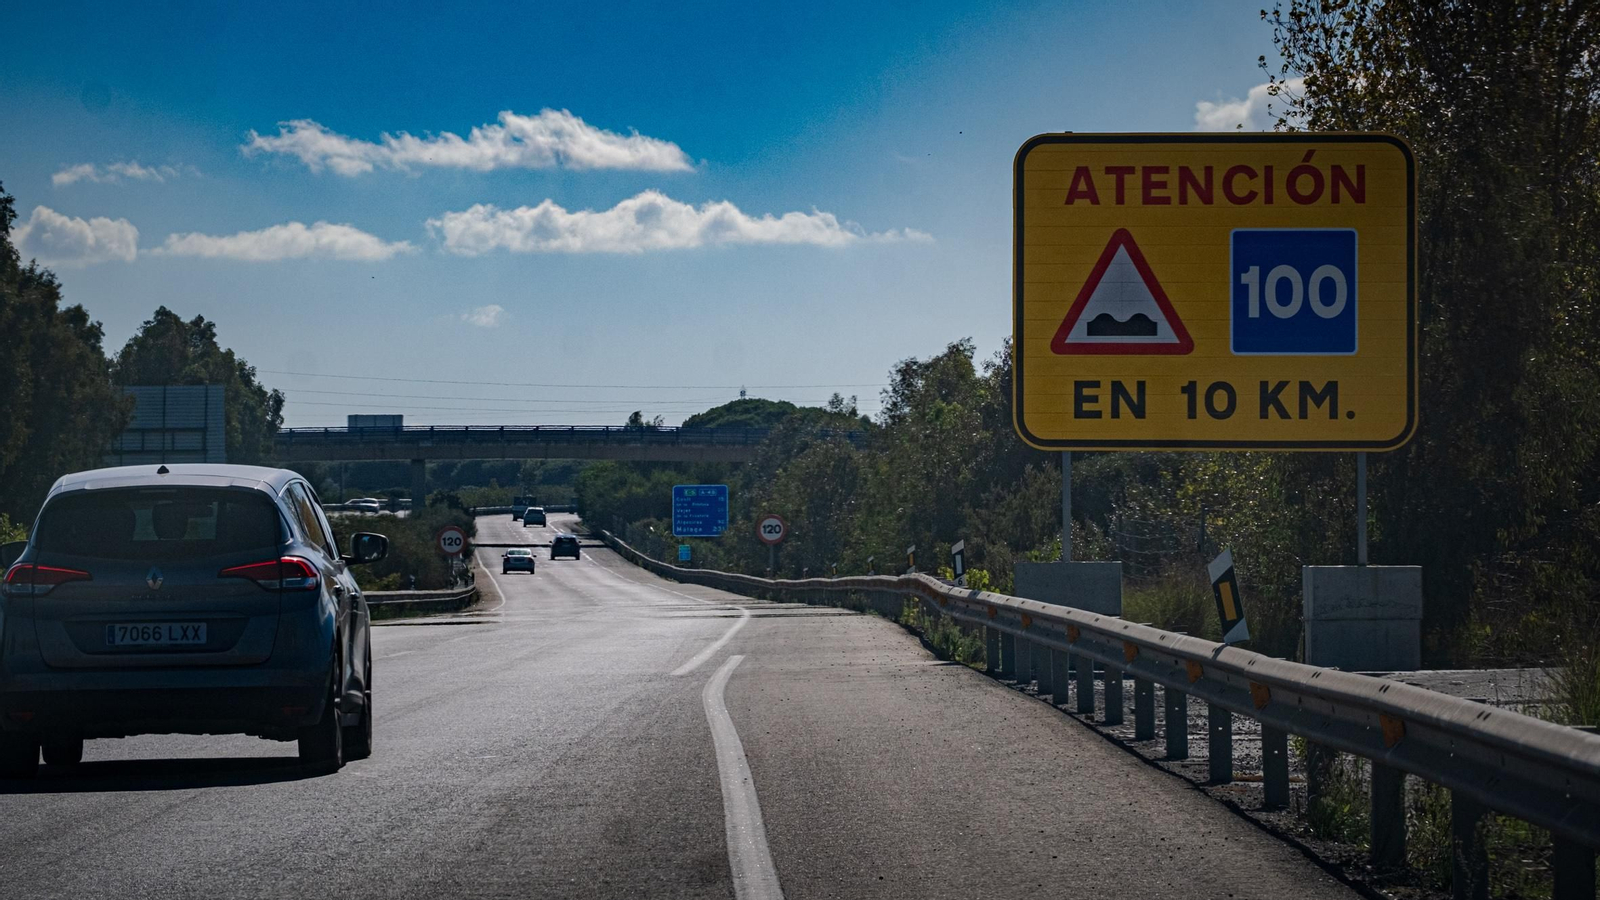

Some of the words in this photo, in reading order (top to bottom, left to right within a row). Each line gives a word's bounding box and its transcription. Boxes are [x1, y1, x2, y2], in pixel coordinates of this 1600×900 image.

[1064, 149, 1366, 205] ATENCIÓN
[1240, 264, 1348, 319] 100
[1073, 380, 1147, 419] EN
[1180, 380, 1238, 420] 10
[1259, 380, 1356, 420] KM.
[762, 524, 782, 534] 120
[442, 537, 462, 546] 120
[957, 578, 963, 586] 6
[118, 626, 162, 642] 7066
[168, 625, 202, 641] LXX
